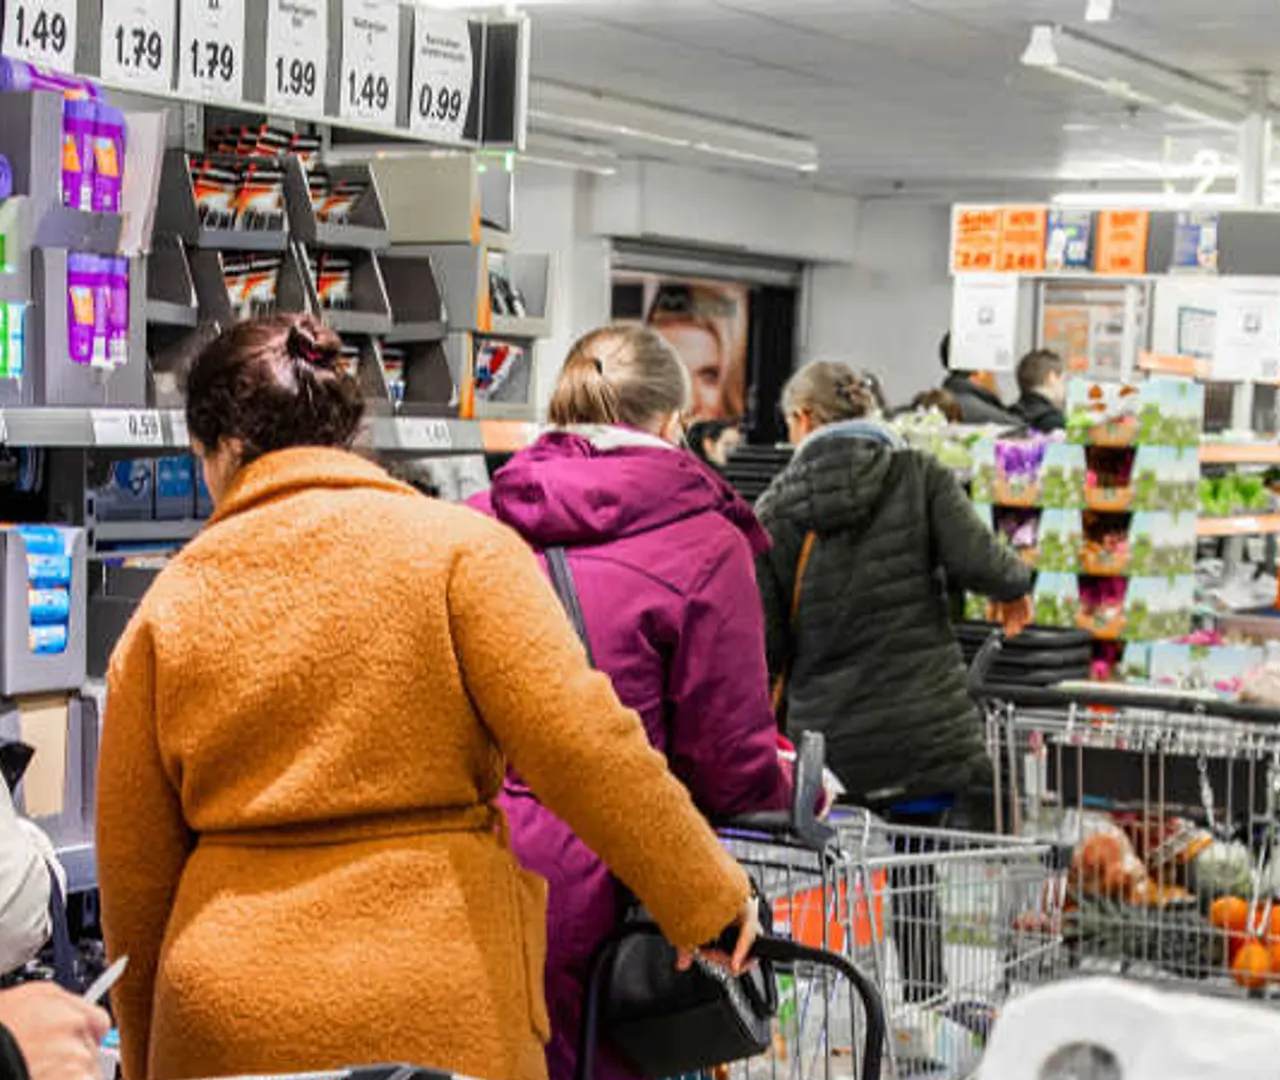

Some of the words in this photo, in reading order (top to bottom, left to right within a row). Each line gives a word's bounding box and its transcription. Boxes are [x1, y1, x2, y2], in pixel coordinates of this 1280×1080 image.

[16, 6, 67, 52] 1.49
[115, 24, 162, 70] 1.79
[190, 38, 234, 81] 1.79
[276, 57, 316, 96] 1.99
[349, 70, 389, 110] 1.49
[419, 83, 462, 121] 0.99
